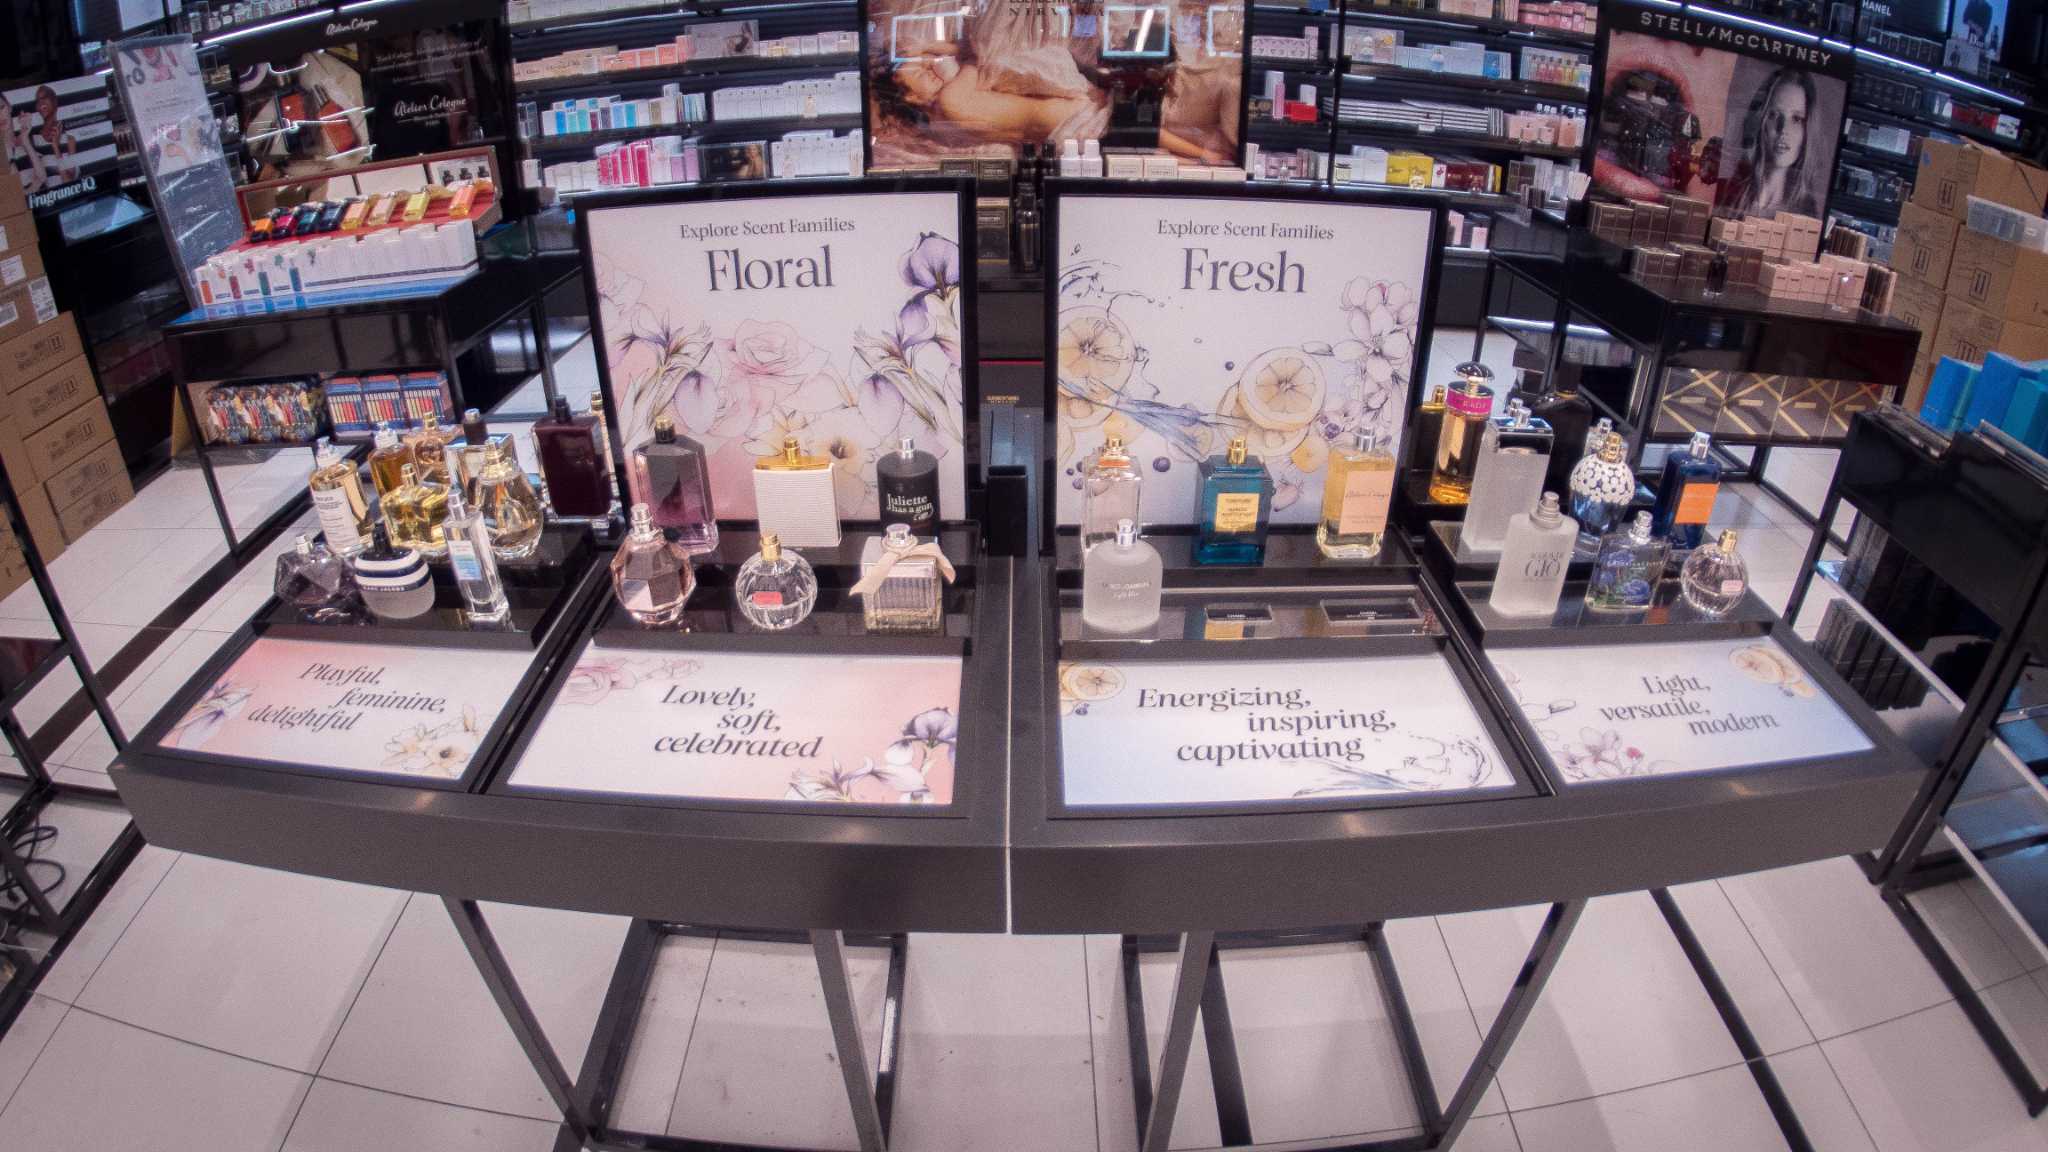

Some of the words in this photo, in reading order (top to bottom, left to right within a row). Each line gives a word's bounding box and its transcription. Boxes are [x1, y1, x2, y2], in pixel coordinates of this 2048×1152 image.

[1862, 0, 1892, 17] HANEL
[430, 94, 467, 112] Cologne
[28, 181, 81, 209] Fragrance
[680, 221, 739, 241] Explore
[743, 220, 786, 235] Scent
[789, 217, 855, 234] Families
[1157, 219, 1220, 239] Explore
[1223, 221, 1266, 238] Scent
[1270, 222, 1334, 240] Families
[704, 244, 836, 292] Floral
[1181, 247, 1306, 293] Fresh
[886, 493, 928, 509] Juliette
[299, 663, 382, 686] Playful,
[1642, 675, 1711, 697] Light,
[328, 687, 447, 713] feminine,
[661, 685, 755, 708] Lovely,
[1137, 687, 1312, 712] Energizing,
[248, 704, 364, 732] delightful
[717, 708, 782, 735] soft,
[1247, 708, 1397, 736] inspiring,
[1600, 697, 1711, 722] versatile,
[1689, 711, 1780, 736] modern
[654, 732, 824, 758] celebrated
[1176, 736, 1365, 766] captivating
